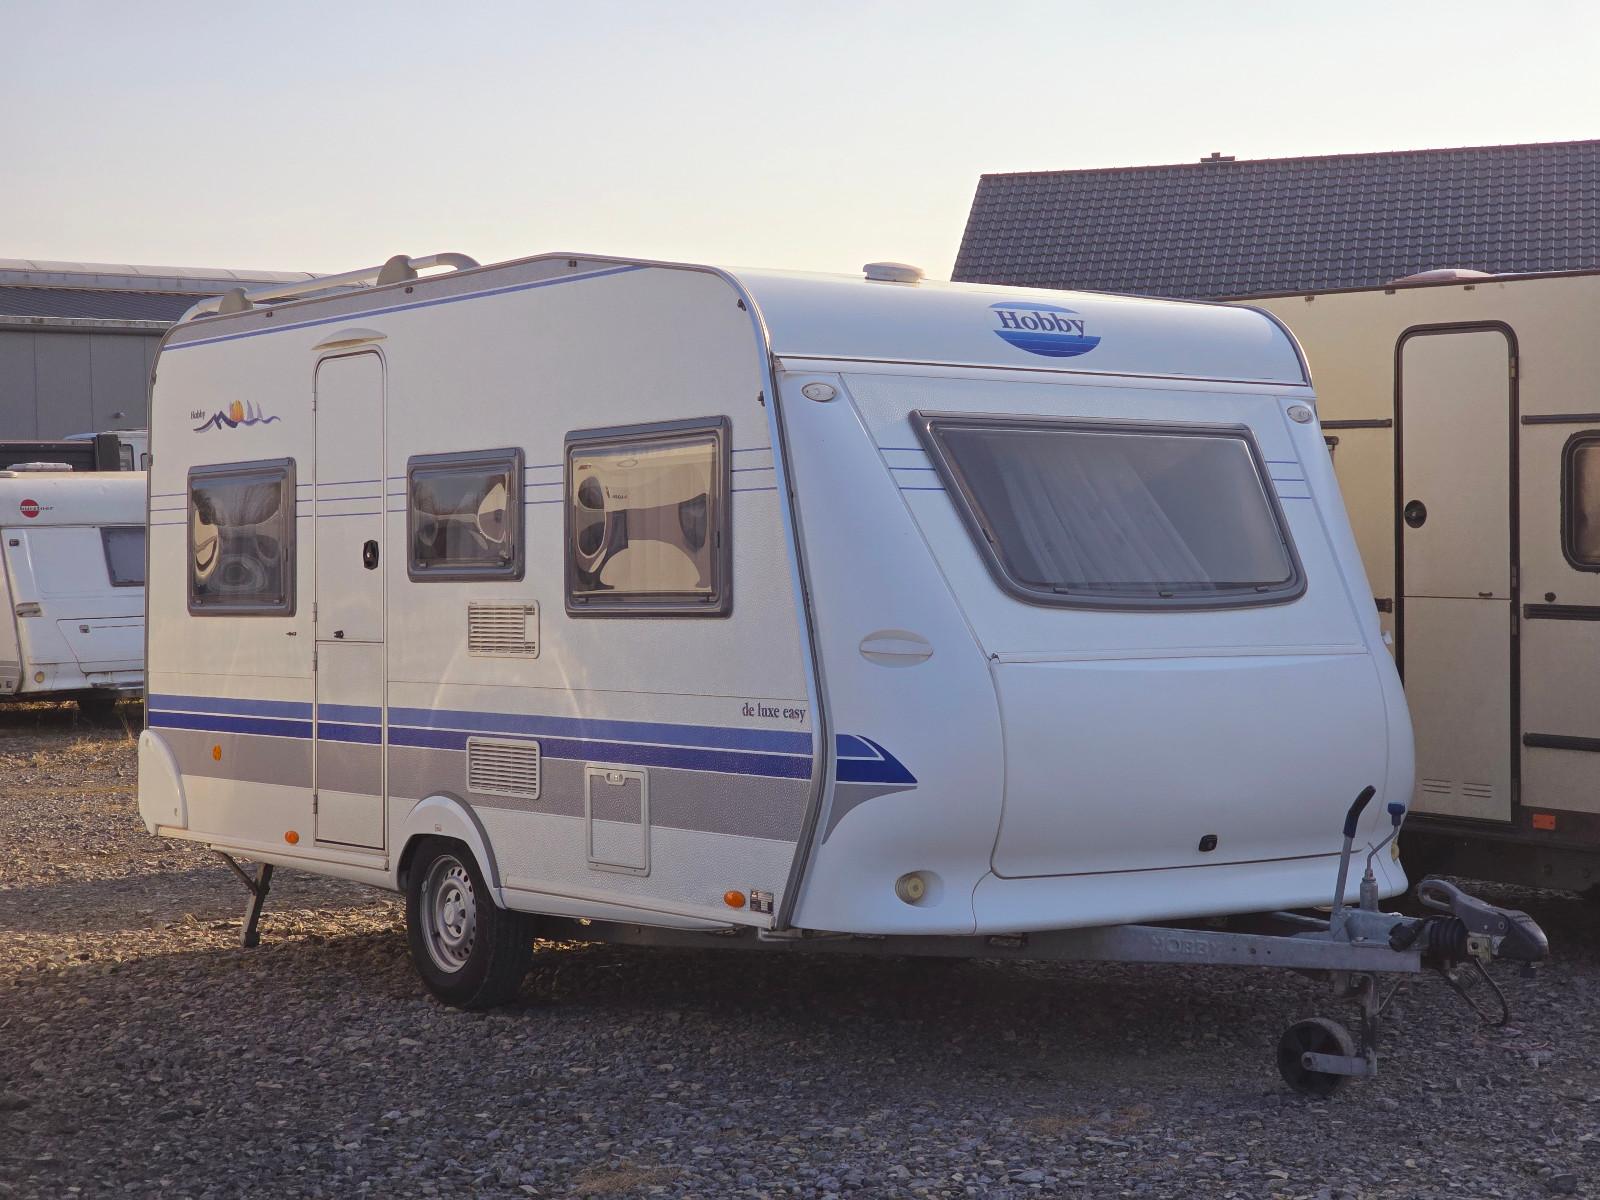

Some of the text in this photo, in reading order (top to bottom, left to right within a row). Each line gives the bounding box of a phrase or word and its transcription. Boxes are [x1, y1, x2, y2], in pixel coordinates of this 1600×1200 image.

[994, 310, 1085, 339] Hobby
[190, 409, 206, 420] Hobby
[742, 702, 806, 723] de luxe easy
